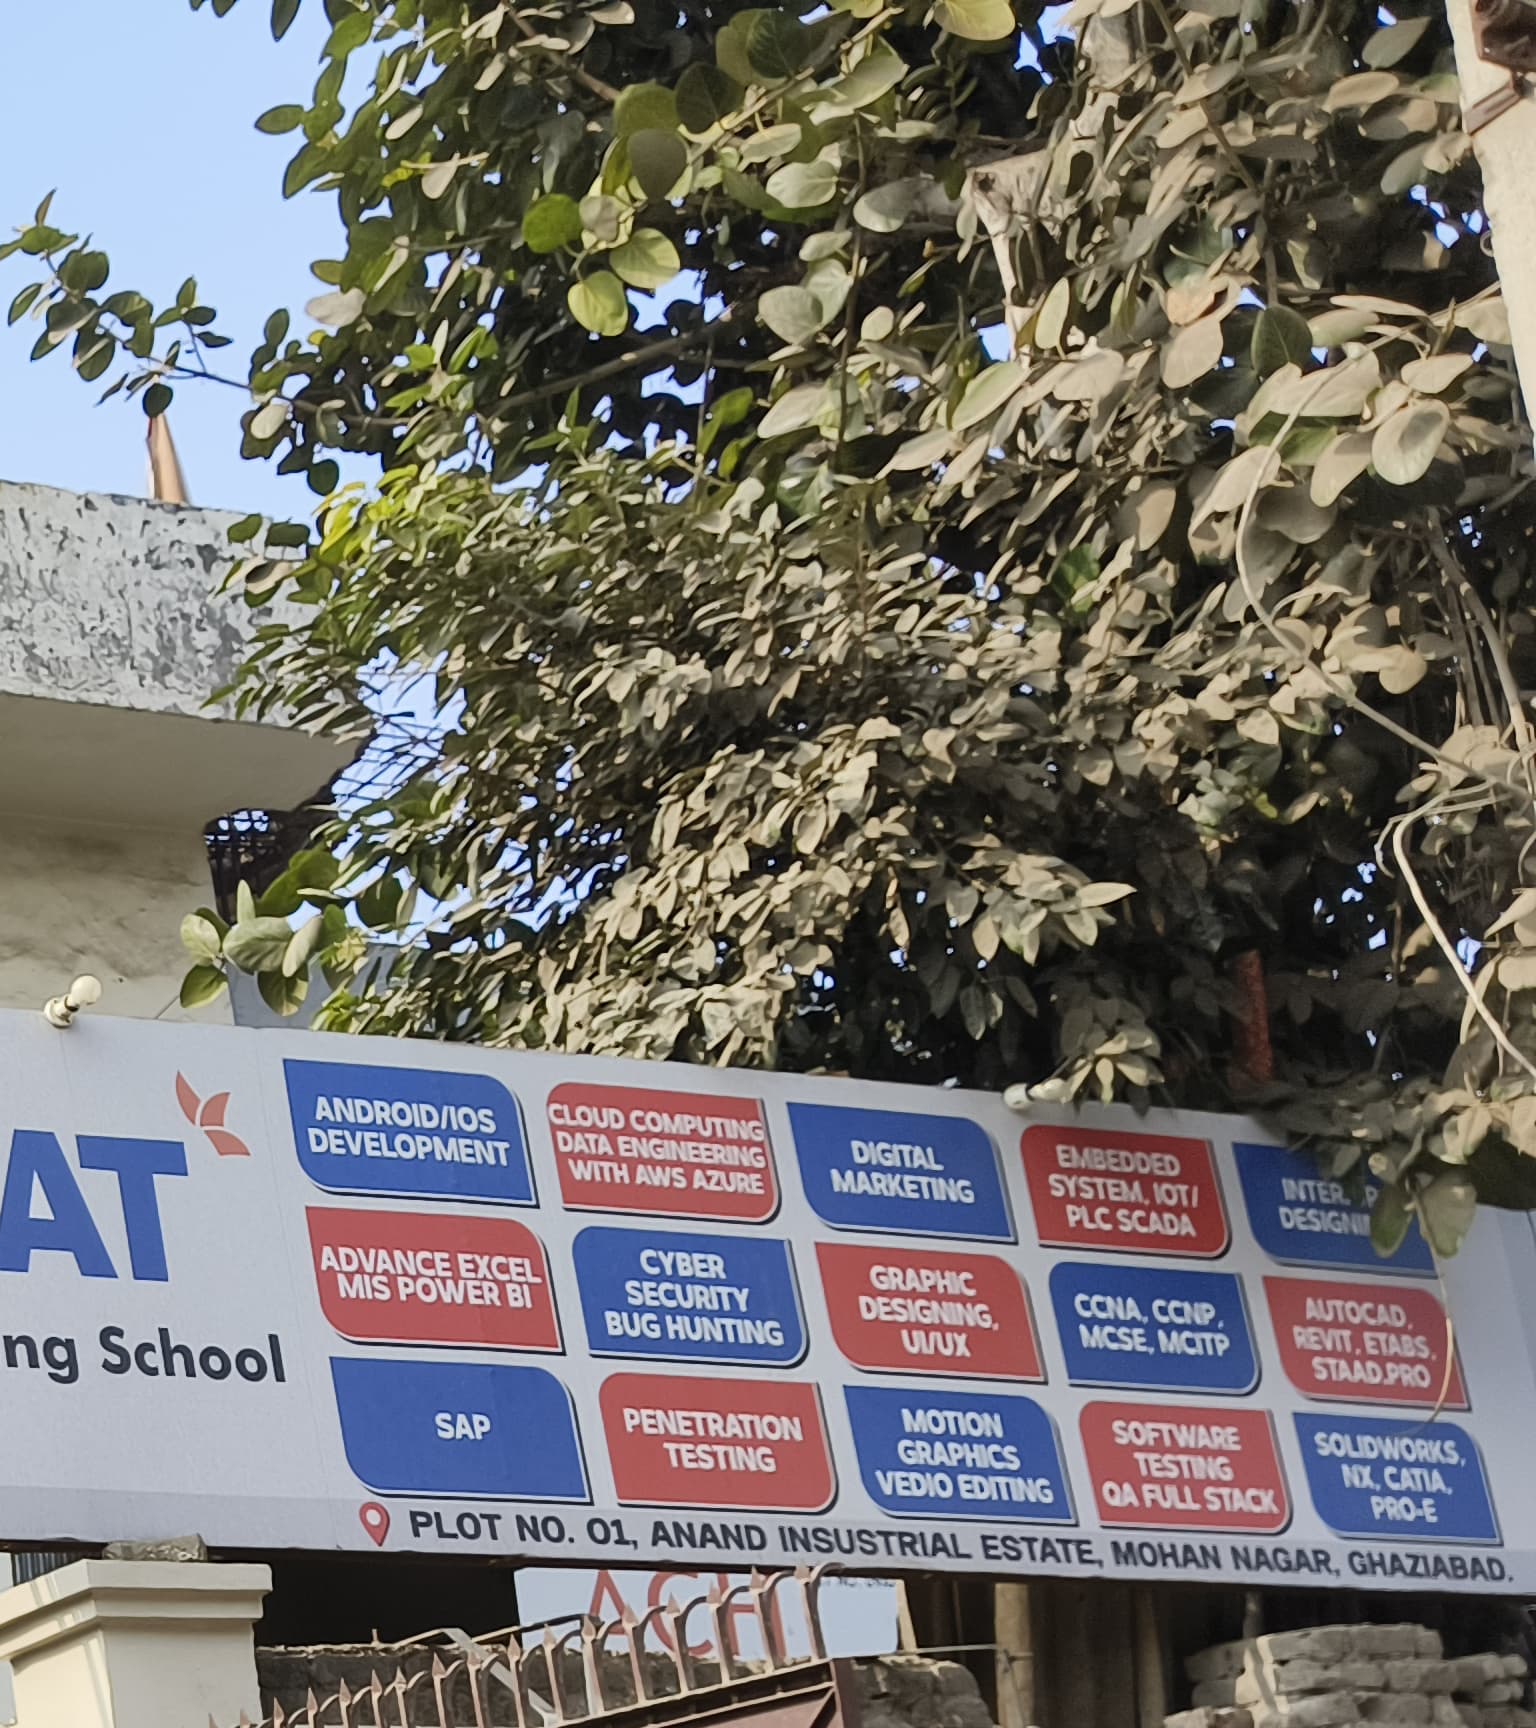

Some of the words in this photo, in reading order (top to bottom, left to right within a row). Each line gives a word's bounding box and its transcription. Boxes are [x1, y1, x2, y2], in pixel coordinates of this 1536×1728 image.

[316, 1097, 496, 1134] ANDROID/IOS
[548, 1104, 625, 1131] CLOUD
[630, 1110, 765, 1142] COMPUTING
[308, 1128, 510, 1166] DEVELOPMENT
[557, 1131, 614, 1156] DATA
[619, 1137, 767, 1168] ENGINEERING
[851, 1141, 944, 1171] DIGITAL
[1056, 1145, 1181, 1176] EMBEDDED
[568, 1159, 630, 1184] WITH
[636, 1165, 687, 1189] AWS
[693, 1170, 764, 1194] AZURE
[831, 1169, 975, 1203] MARKETING
[1066, 1205, 1113, 1231] PLC
[1118, 1209, 1196, 1236] SCADA
[321, 1247, 453, 1277] ADVANCE
[458, 1254, 541, 1282] EXCEL
[640, 1250, 726, 1280] CYBER
[338, 1273, 390, 1301] MIS
[397, 1276, 500, 1305] POWER
[506, 1281, 534, 1308] BI
[625, 1280, 749, 1312] SECURITY
[870, 1266, 976, 1296] GRAPHIC
[1074, 1294, 1148, 1324] CCNA,
[605, 1311, 661, 1338] BUG
[665, 1315, 784, 1346] HUNTING
[902, 1330, 970, 1357] UI/UX
[1080, 1324, 1154, 1354] MCSE,
[1158, 1329, 1230, 1356] MCITP
[100, 1326, 285, 1382] School
[435, 1413, 490, 1440] SAP
[624, 1408, 803, 1441] PENETRATION
[902, 1409, 1003, 1438] MOTION
[1112, 1420, 1241, 1451] SOFTWARE
[663, 1443, 776, 1472] TESTING
[898, 1440, 1020, 1471] GRAPHICS
[1134, 1452, 1234, 1481] TESTING
[876, 1471, 953, 1498] VEDIO
[959, 1474, 1054, 1504] EDITING
[1102, 1482, 1139, 1507] QA
[1143, 1484, 1201, 1510] FULL
[1204, 1487, 1279, 1513] STACK
[1371, 1496, 1437, 1523] PRO-E
[410, 1511, 501, 1540] PLOT
[516, 1515, 574, 1543] NO.
[652, 1521, 764, 1550] ANAND
[779, 1527, 972, 1559] INSUSTRIAL
[980, 1535, 1103, 1567] ESTATE,
[1111, 1541, 1221, 1569] MOHAN
